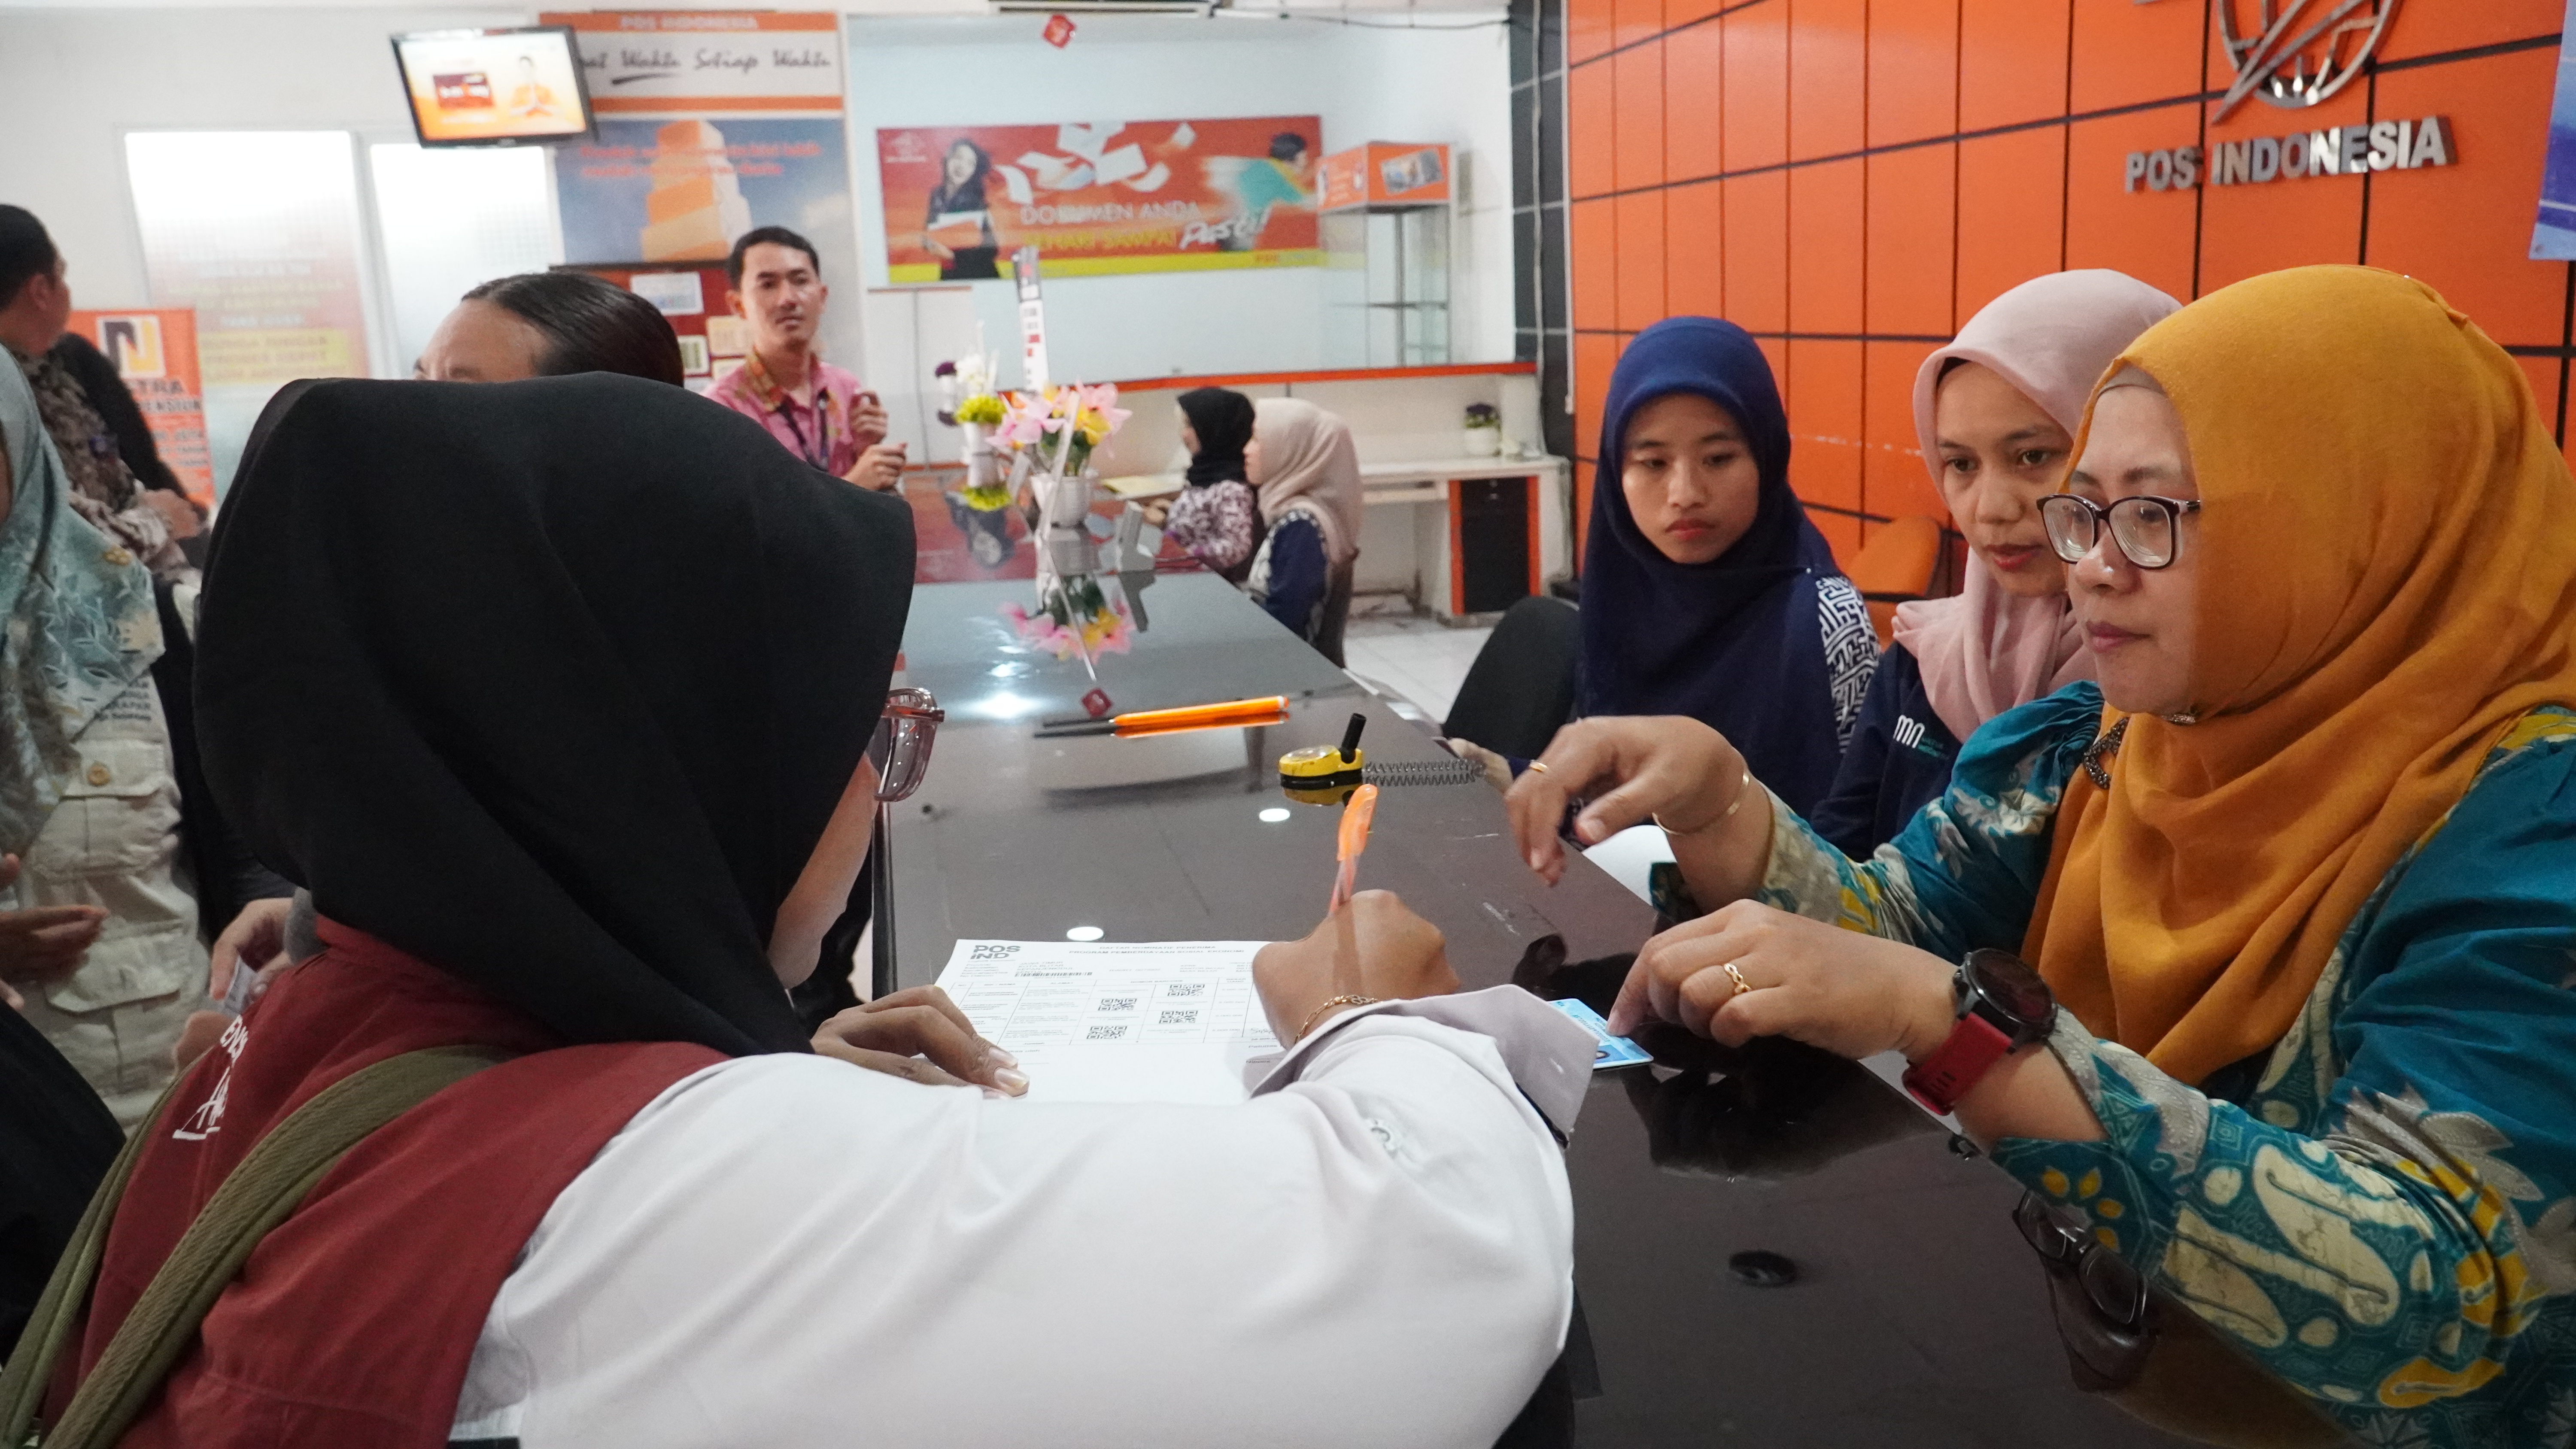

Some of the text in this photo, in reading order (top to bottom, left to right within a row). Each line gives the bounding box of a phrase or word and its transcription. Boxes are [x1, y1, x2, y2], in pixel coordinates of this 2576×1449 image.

[2125, 115, 2451, 193] POS INDONESIA
[1020, 200, 1202, 225] DOKUMEN ANDA
